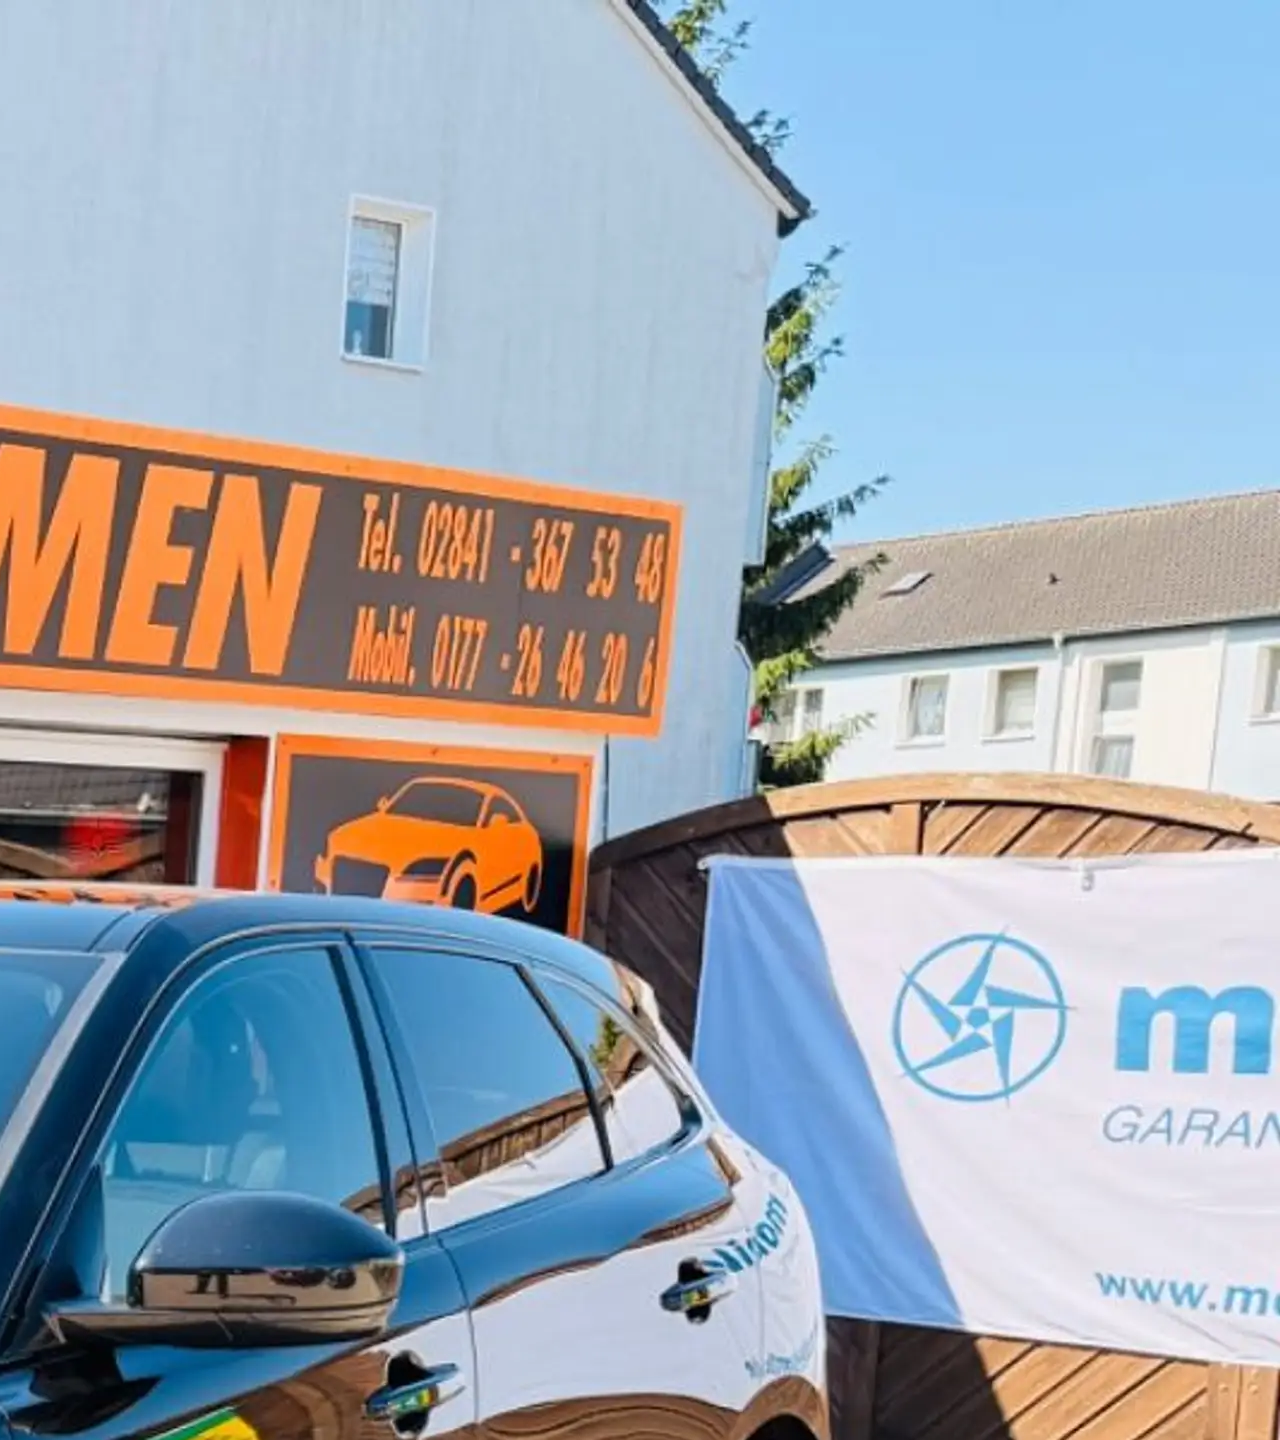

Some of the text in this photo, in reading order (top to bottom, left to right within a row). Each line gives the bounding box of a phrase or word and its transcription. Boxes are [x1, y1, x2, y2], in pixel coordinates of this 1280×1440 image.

[357, 491, 404, 575] Tel.
[416, 500, 496, 584] 02841
[586, 526, 623, 600] 53
[635, 532, 667, 604] 48
[347, 604, 417, 688] Mobil.
[430, 613, 489, 691] 0177
[556, 630, 588, 702] 46
[594, 632, 629, 705] 20
